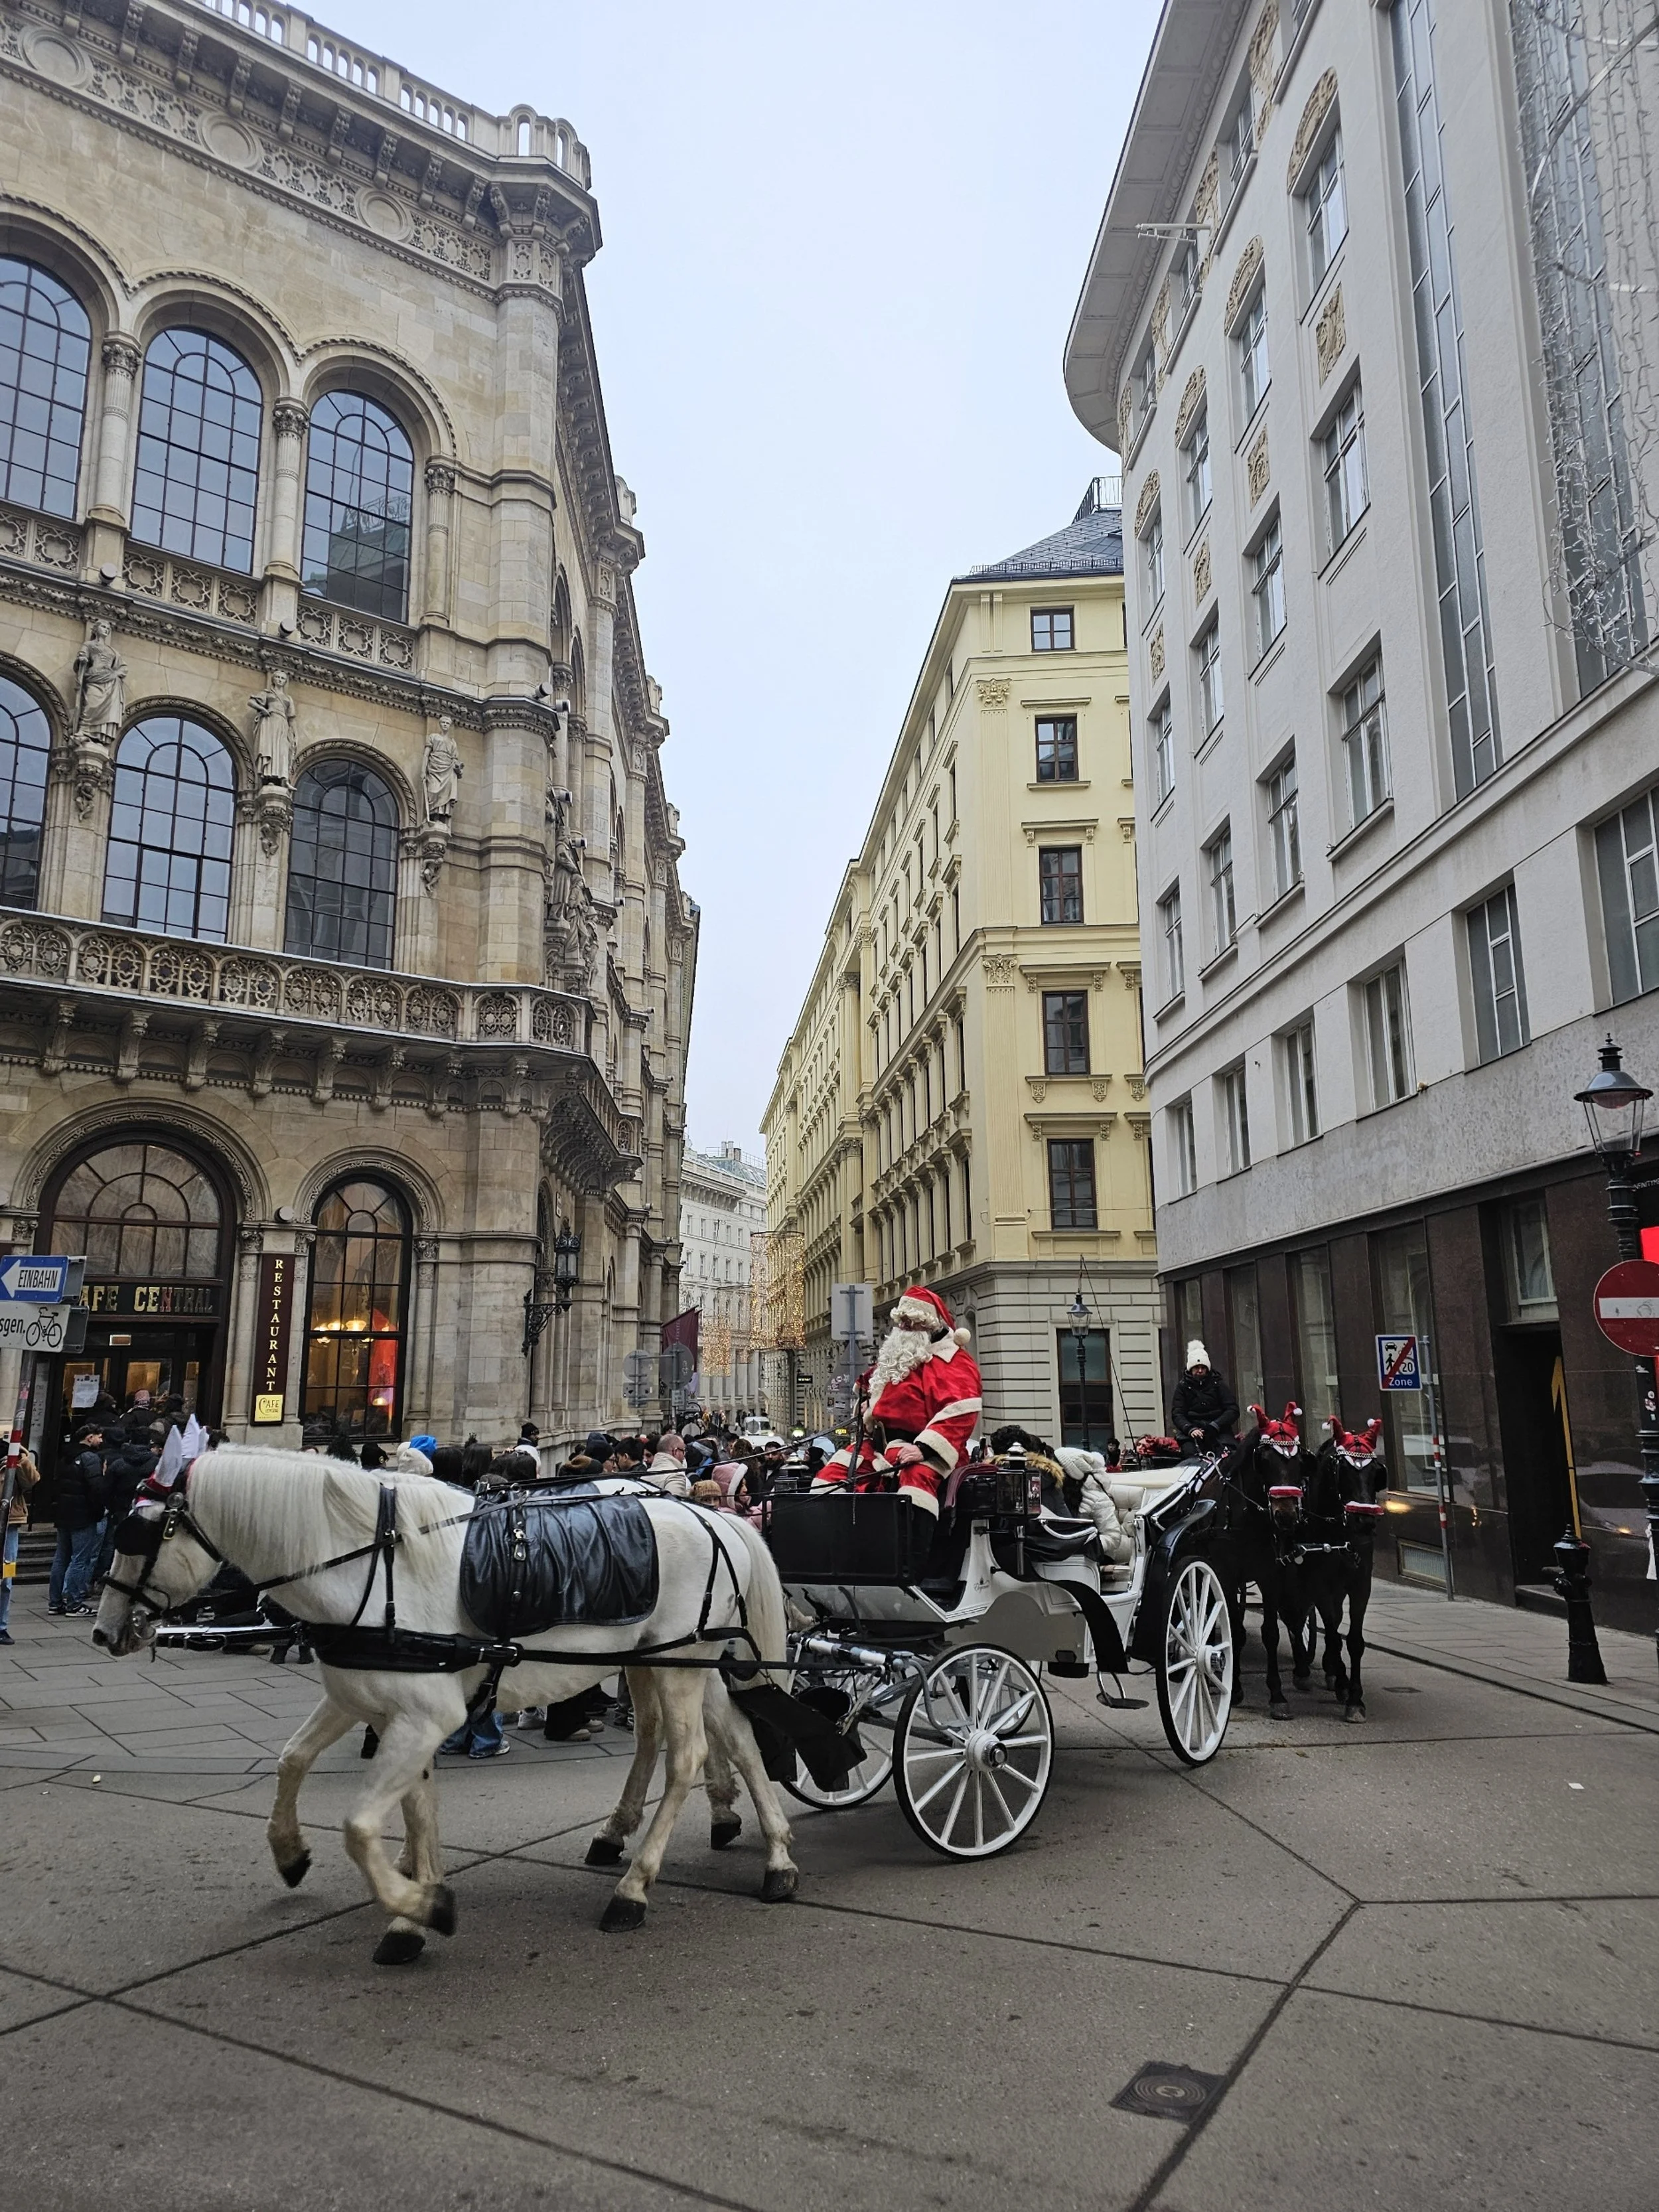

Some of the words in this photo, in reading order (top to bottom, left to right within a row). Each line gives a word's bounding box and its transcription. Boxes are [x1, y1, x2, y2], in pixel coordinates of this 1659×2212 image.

[18, 1270, 58, 1289] EINBAHN
[79, 1286, 119, 1311] AFE
[133, 1286, 212, 1313] CENTRAL
[266, 1259, 284, 1391] RESTAURANT
[1402, 1362, 1413, 1372] 20
[1389, 1377, 1413, 1386] Zone
